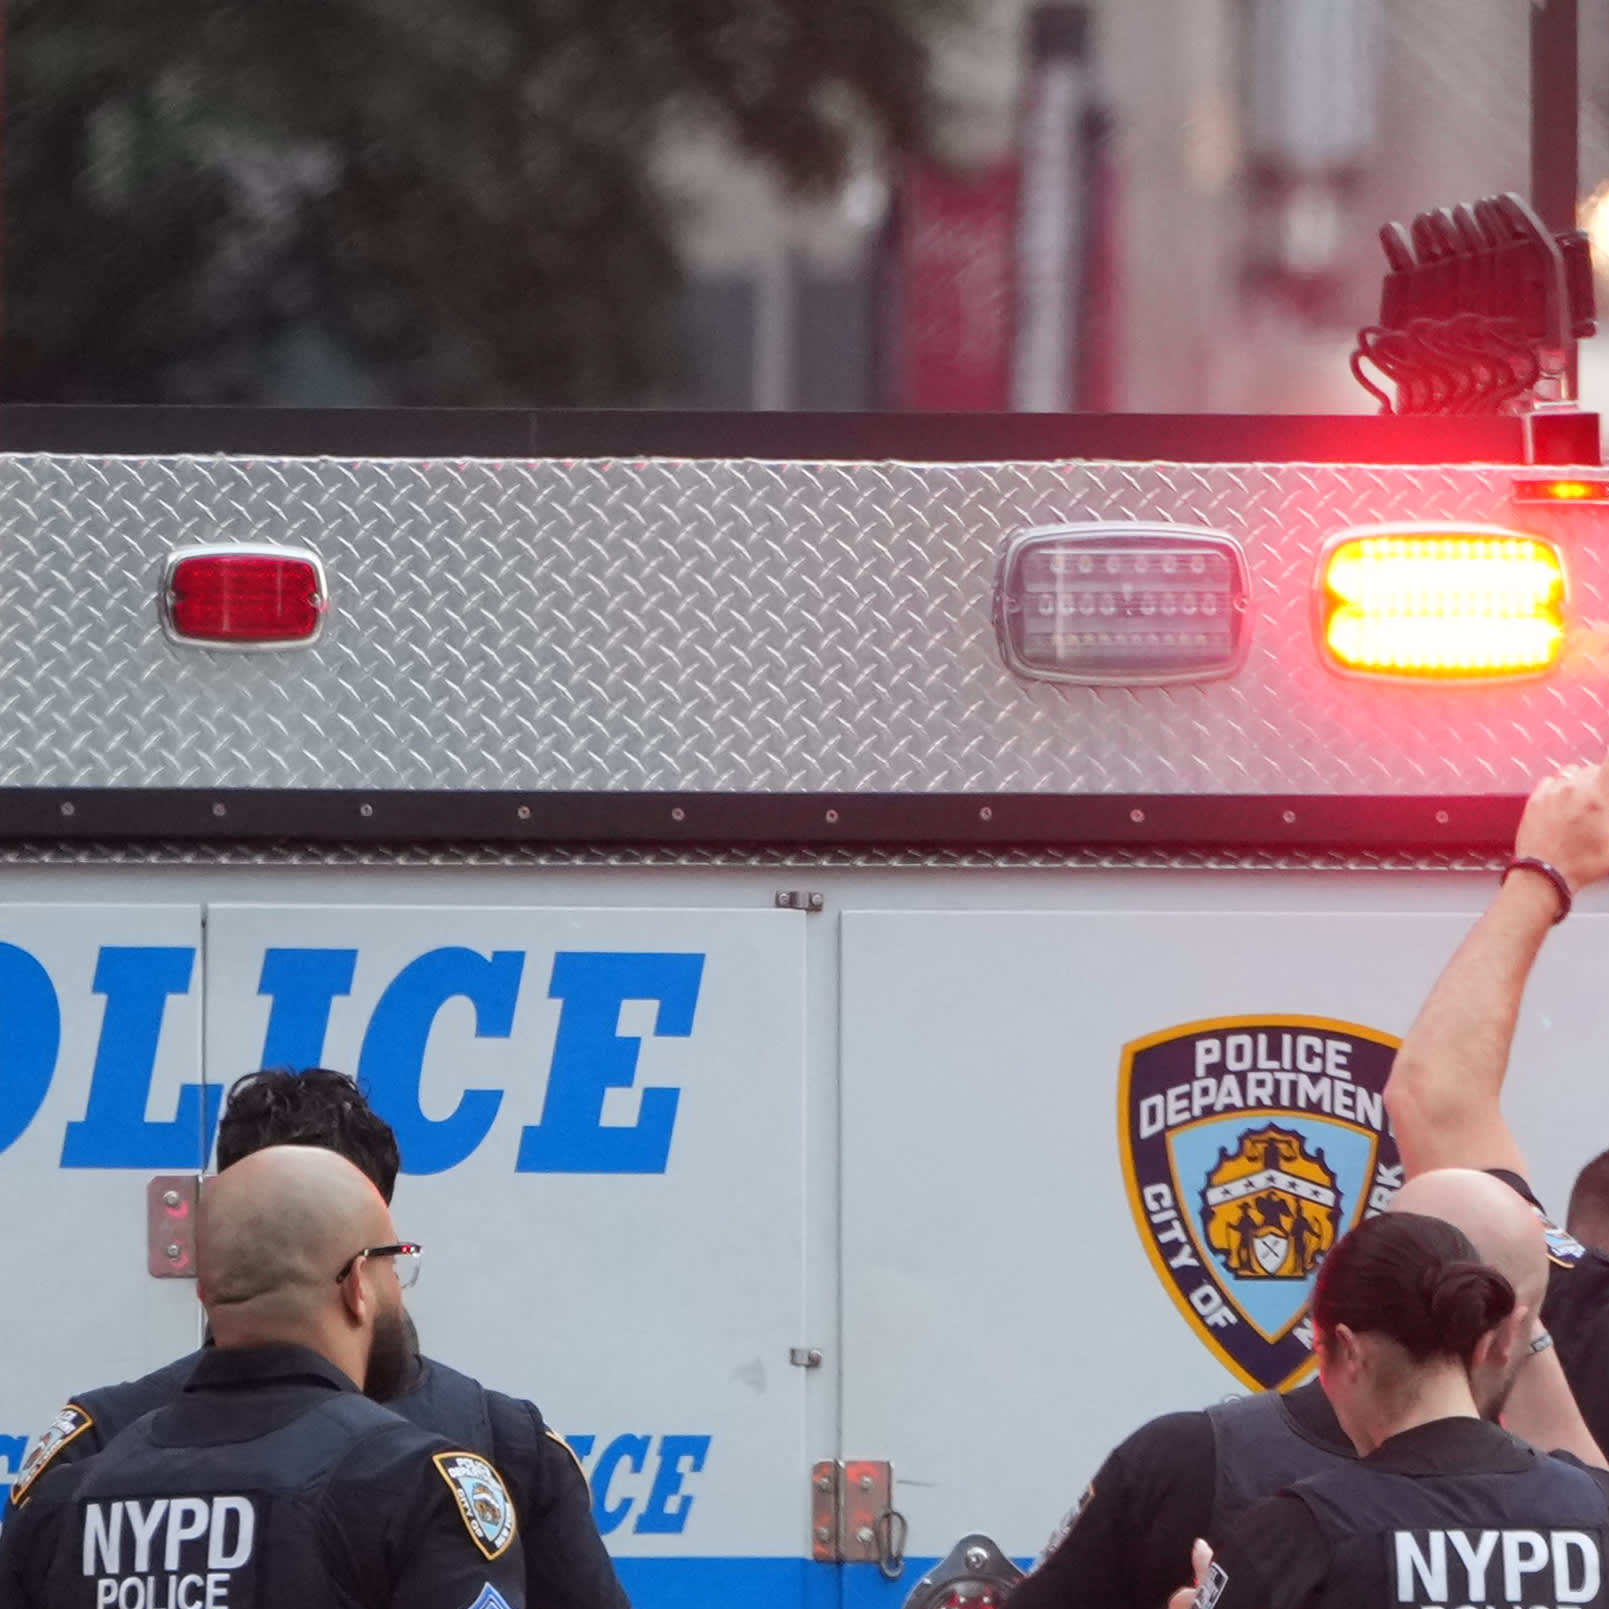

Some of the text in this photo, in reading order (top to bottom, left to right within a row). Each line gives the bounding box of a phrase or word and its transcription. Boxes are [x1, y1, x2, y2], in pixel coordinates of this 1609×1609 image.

[1194, 1033, 1353, 1080] POLICE
[1139, 1070, 1396, 1140] DEPARTMEN
[1143, 1182, 1238, 1329] CITY OF
[82, 1495, 256, 1577] NYPD
[1395, 1530, 1601, 1603] NYPD
